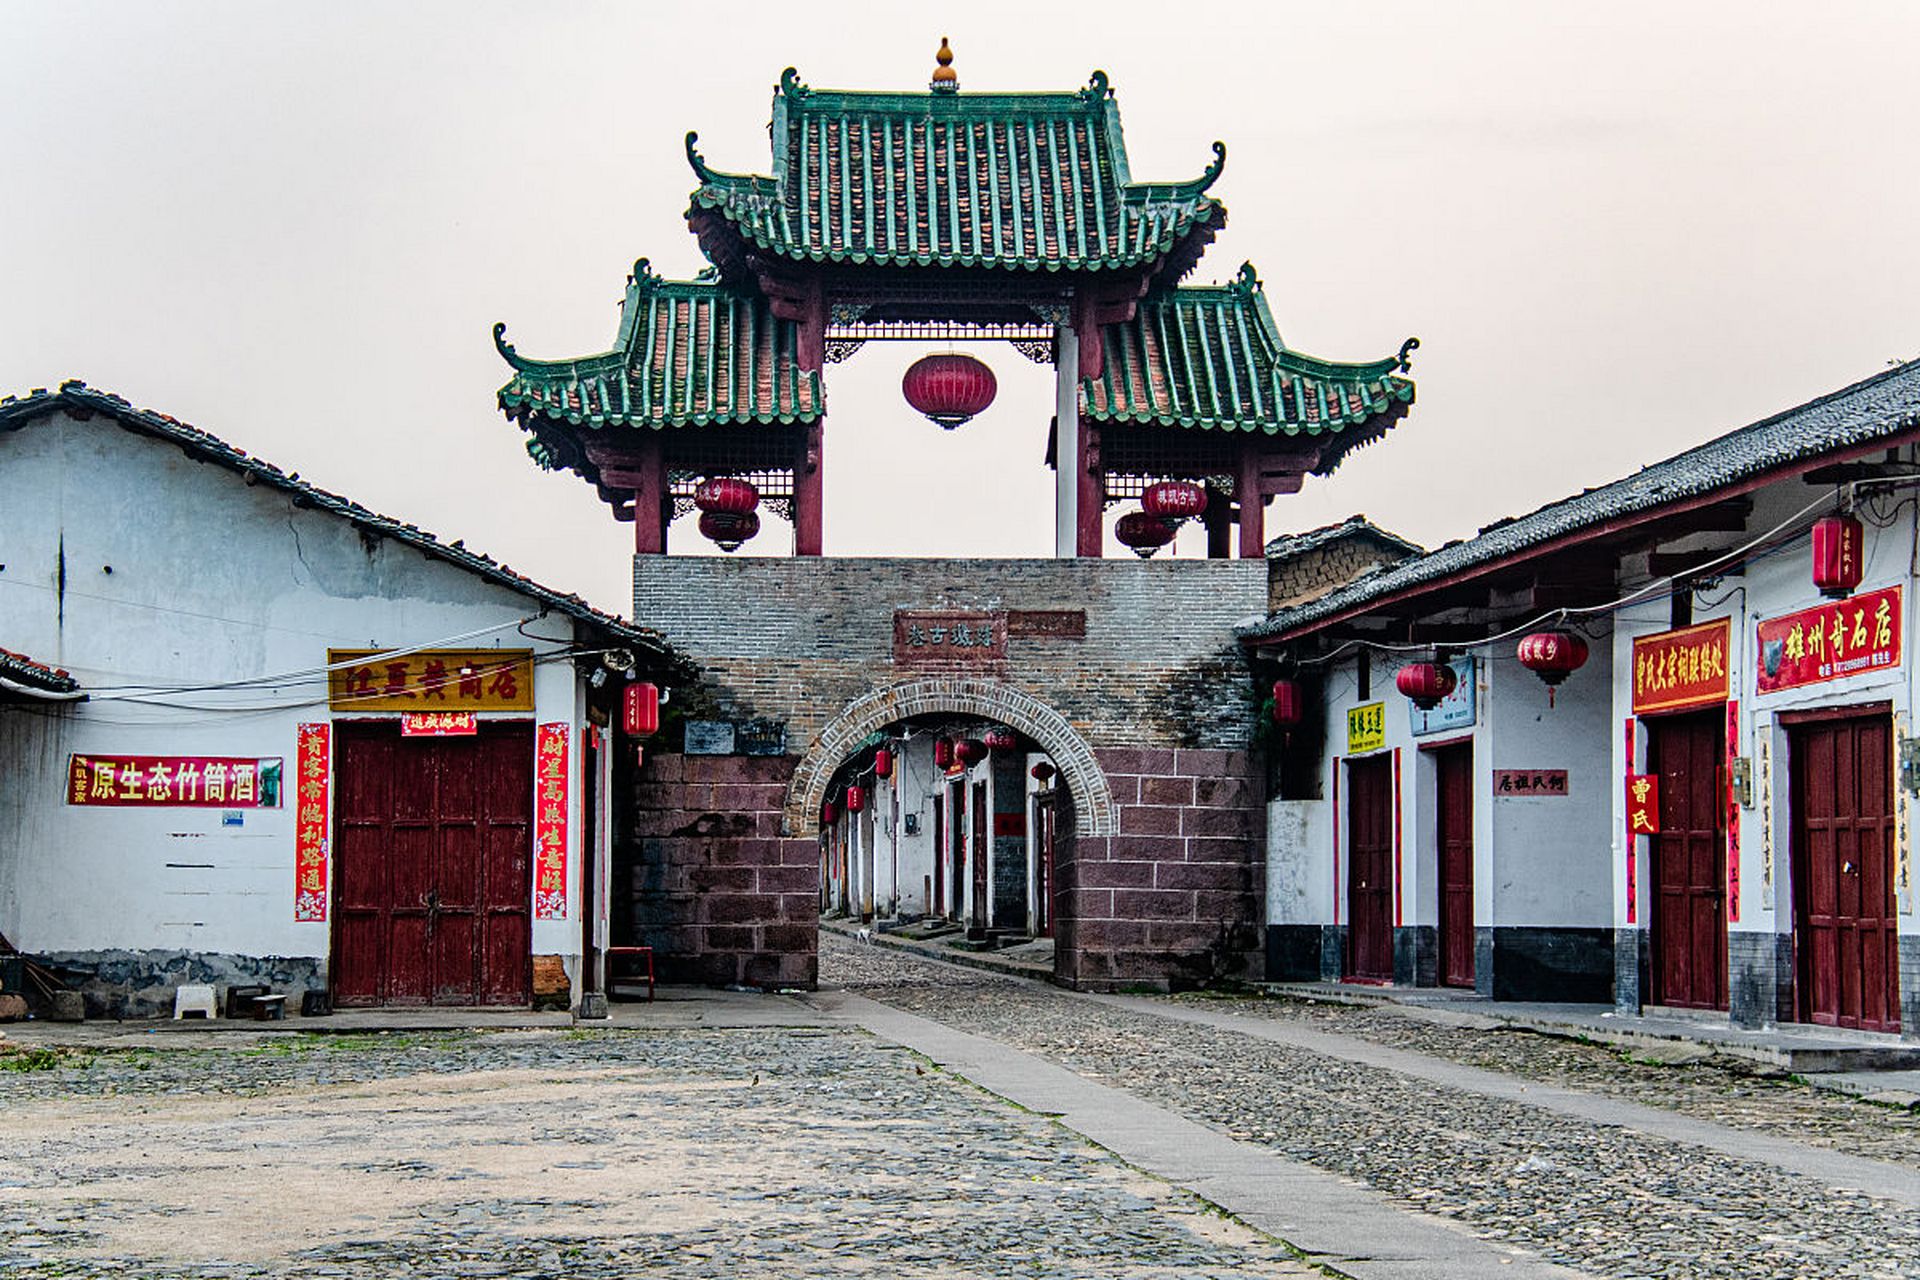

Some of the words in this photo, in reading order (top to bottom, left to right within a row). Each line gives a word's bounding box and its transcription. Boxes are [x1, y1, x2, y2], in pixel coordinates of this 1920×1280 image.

[1785, 598, 1892, 667] 雄州奇石店
[90, 761, 255, 802] 原生态竹筒酒
[1631, 778, 1655, 832] 曾氏
